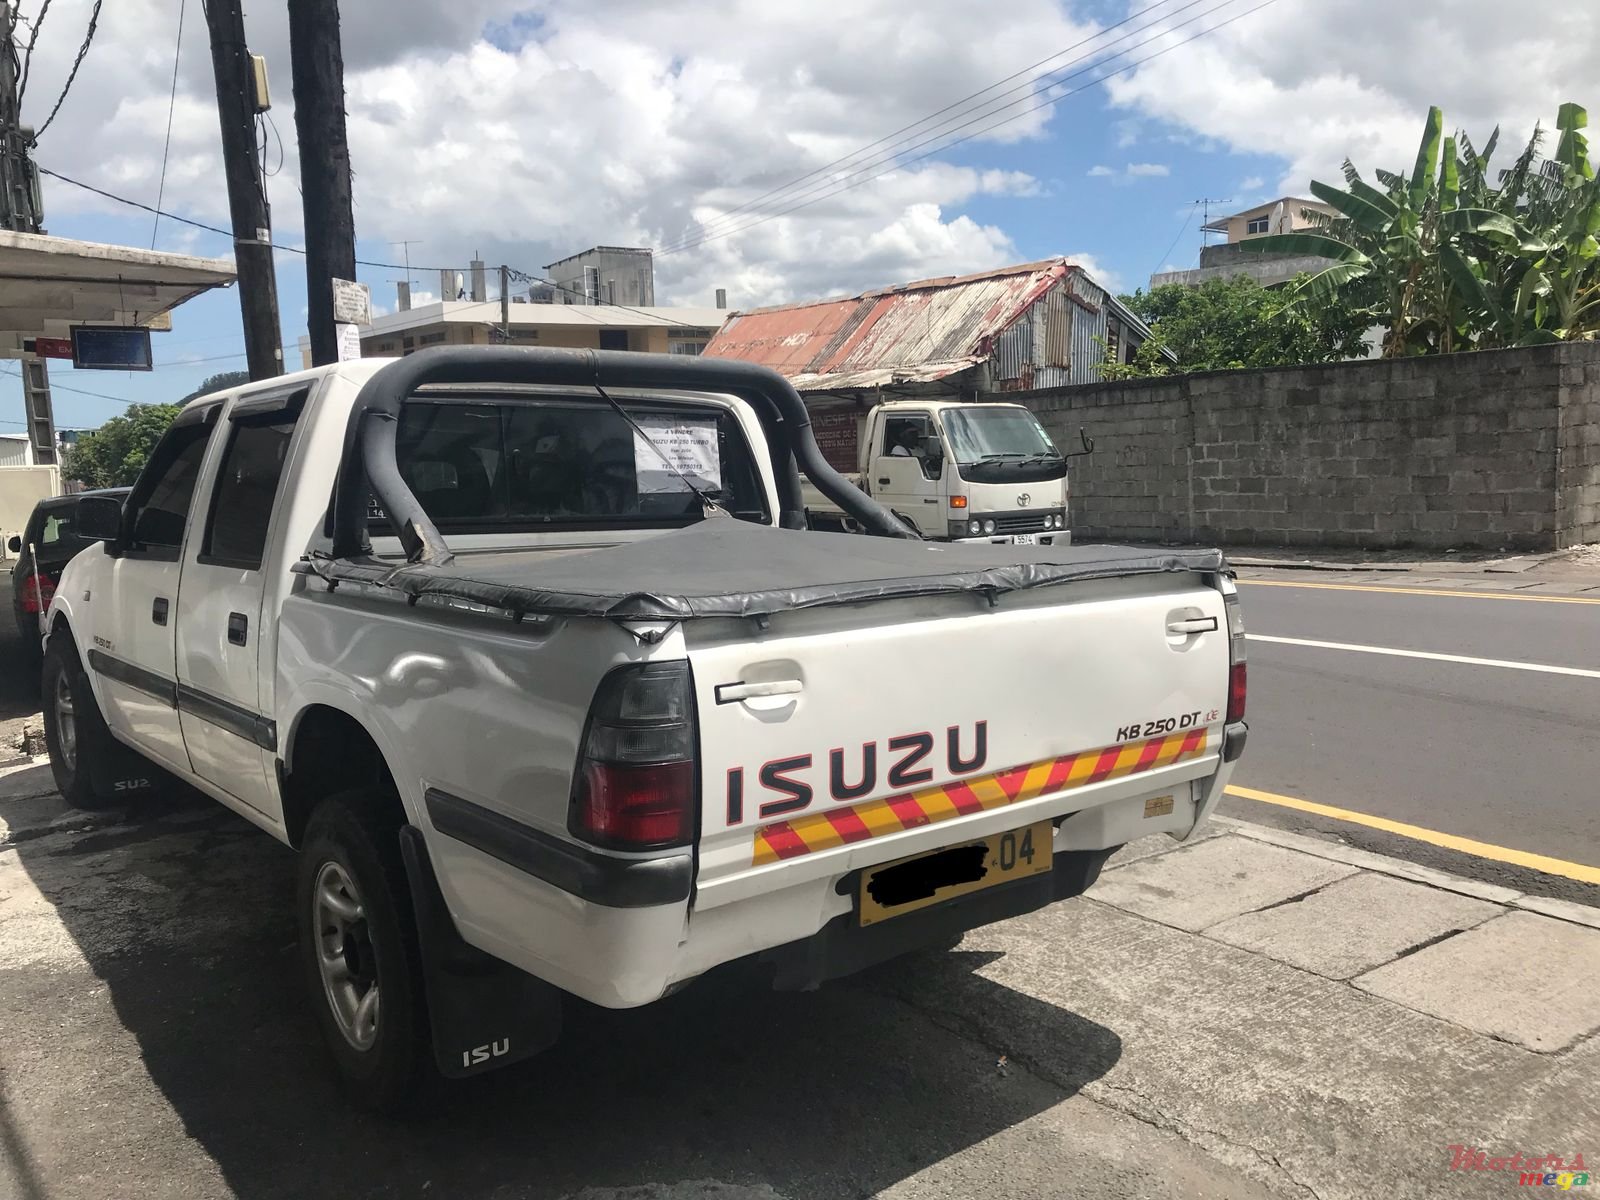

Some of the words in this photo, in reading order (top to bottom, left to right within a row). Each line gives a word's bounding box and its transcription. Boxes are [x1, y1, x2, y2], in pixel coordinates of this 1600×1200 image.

[1116, 724, 1141, 742] KB
[1144, 718, 1176, 737] 250
[1179, 711, 1201, 729] DT
[726, 720, 987, 827] ISUZU
[1000, 828, 1035, 871] 04
[463, 1037, 509, 1068] ISU
